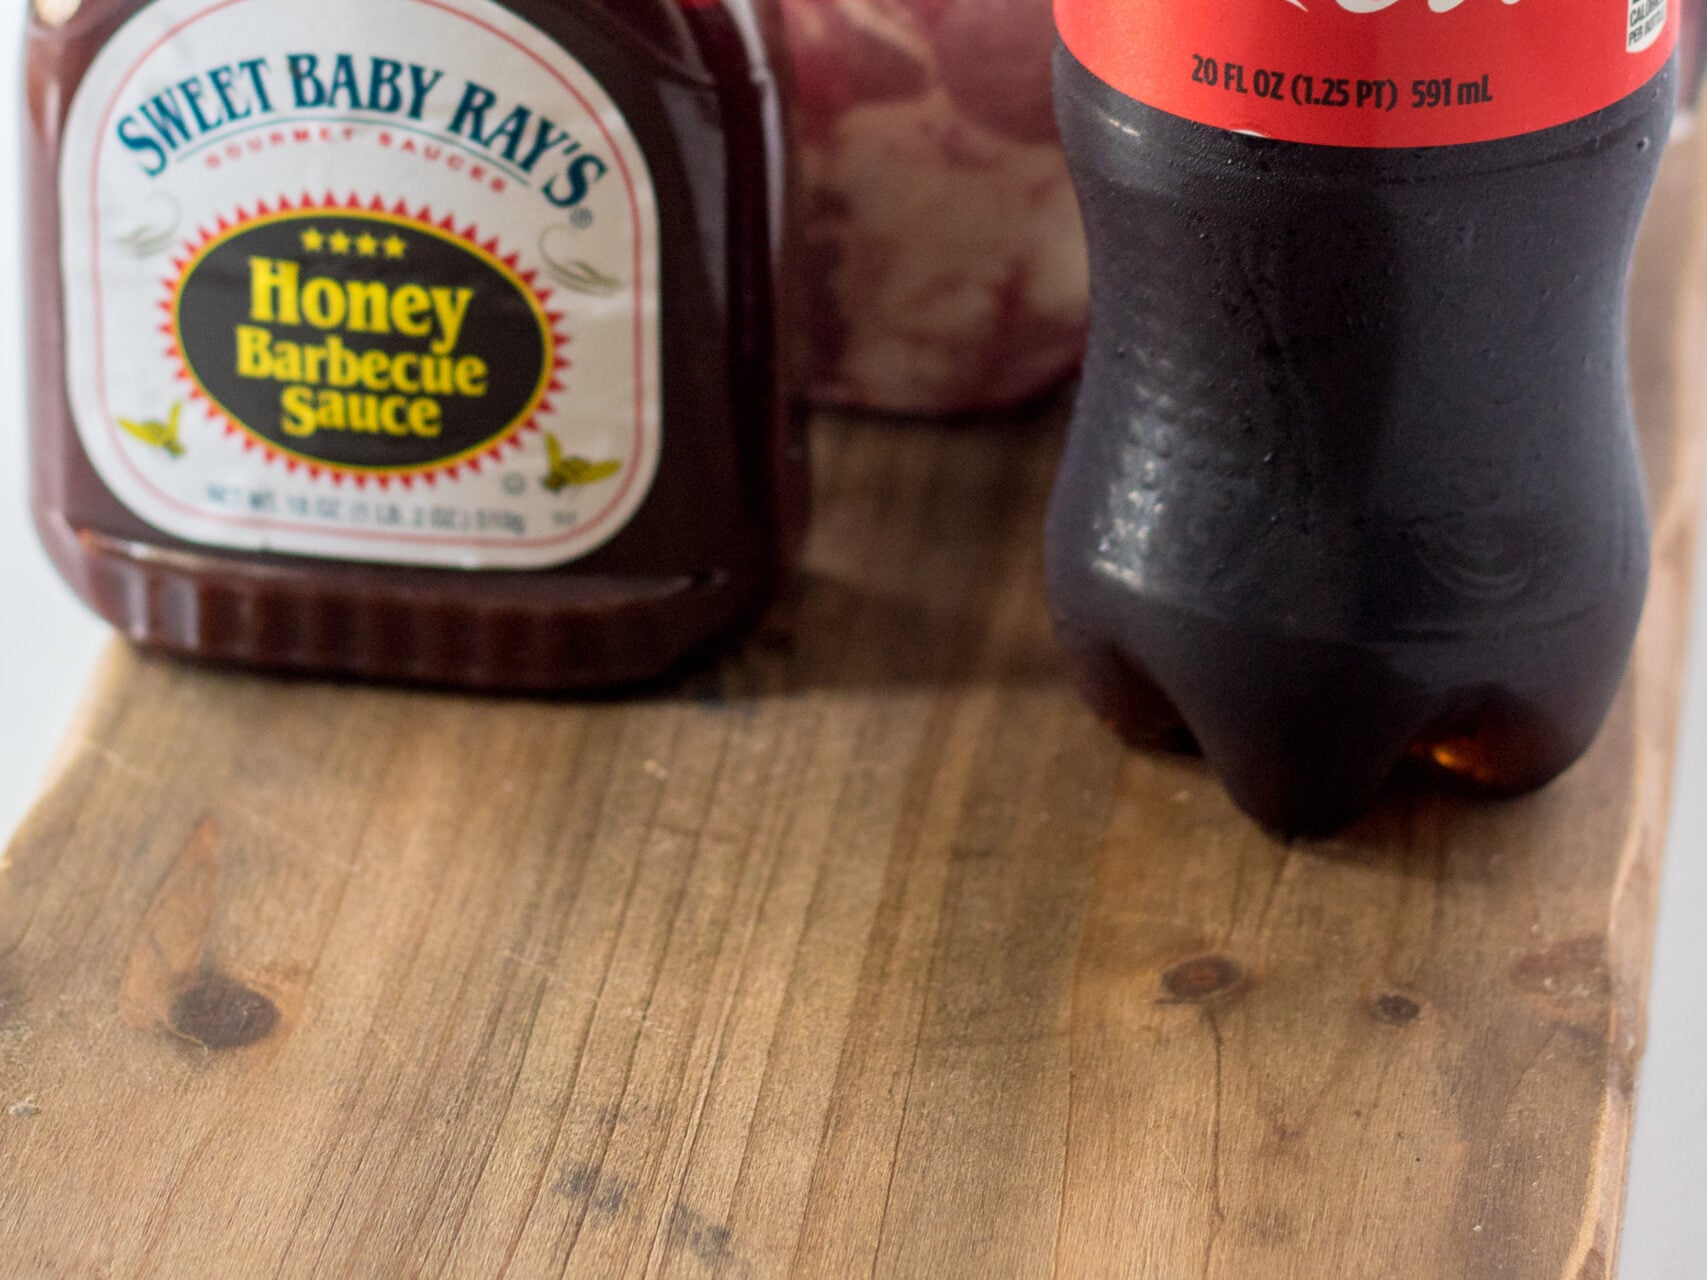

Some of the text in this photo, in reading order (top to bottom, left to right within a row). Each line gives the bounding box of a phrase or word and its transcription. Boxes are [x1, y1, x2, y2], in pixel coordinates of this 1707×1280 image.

[1628, 26, 1643, 47] PER
[1191, 53, 1494, 112] 20 FL OZ (1.25 PT) 591 mL
[116, 53, 609, 209] SWEET BABY RAY'S
[248, 255, 474, 356] Honey
[235, 324, 489, 398] Barbecue
[281, 387, 442, 438] Sauce
